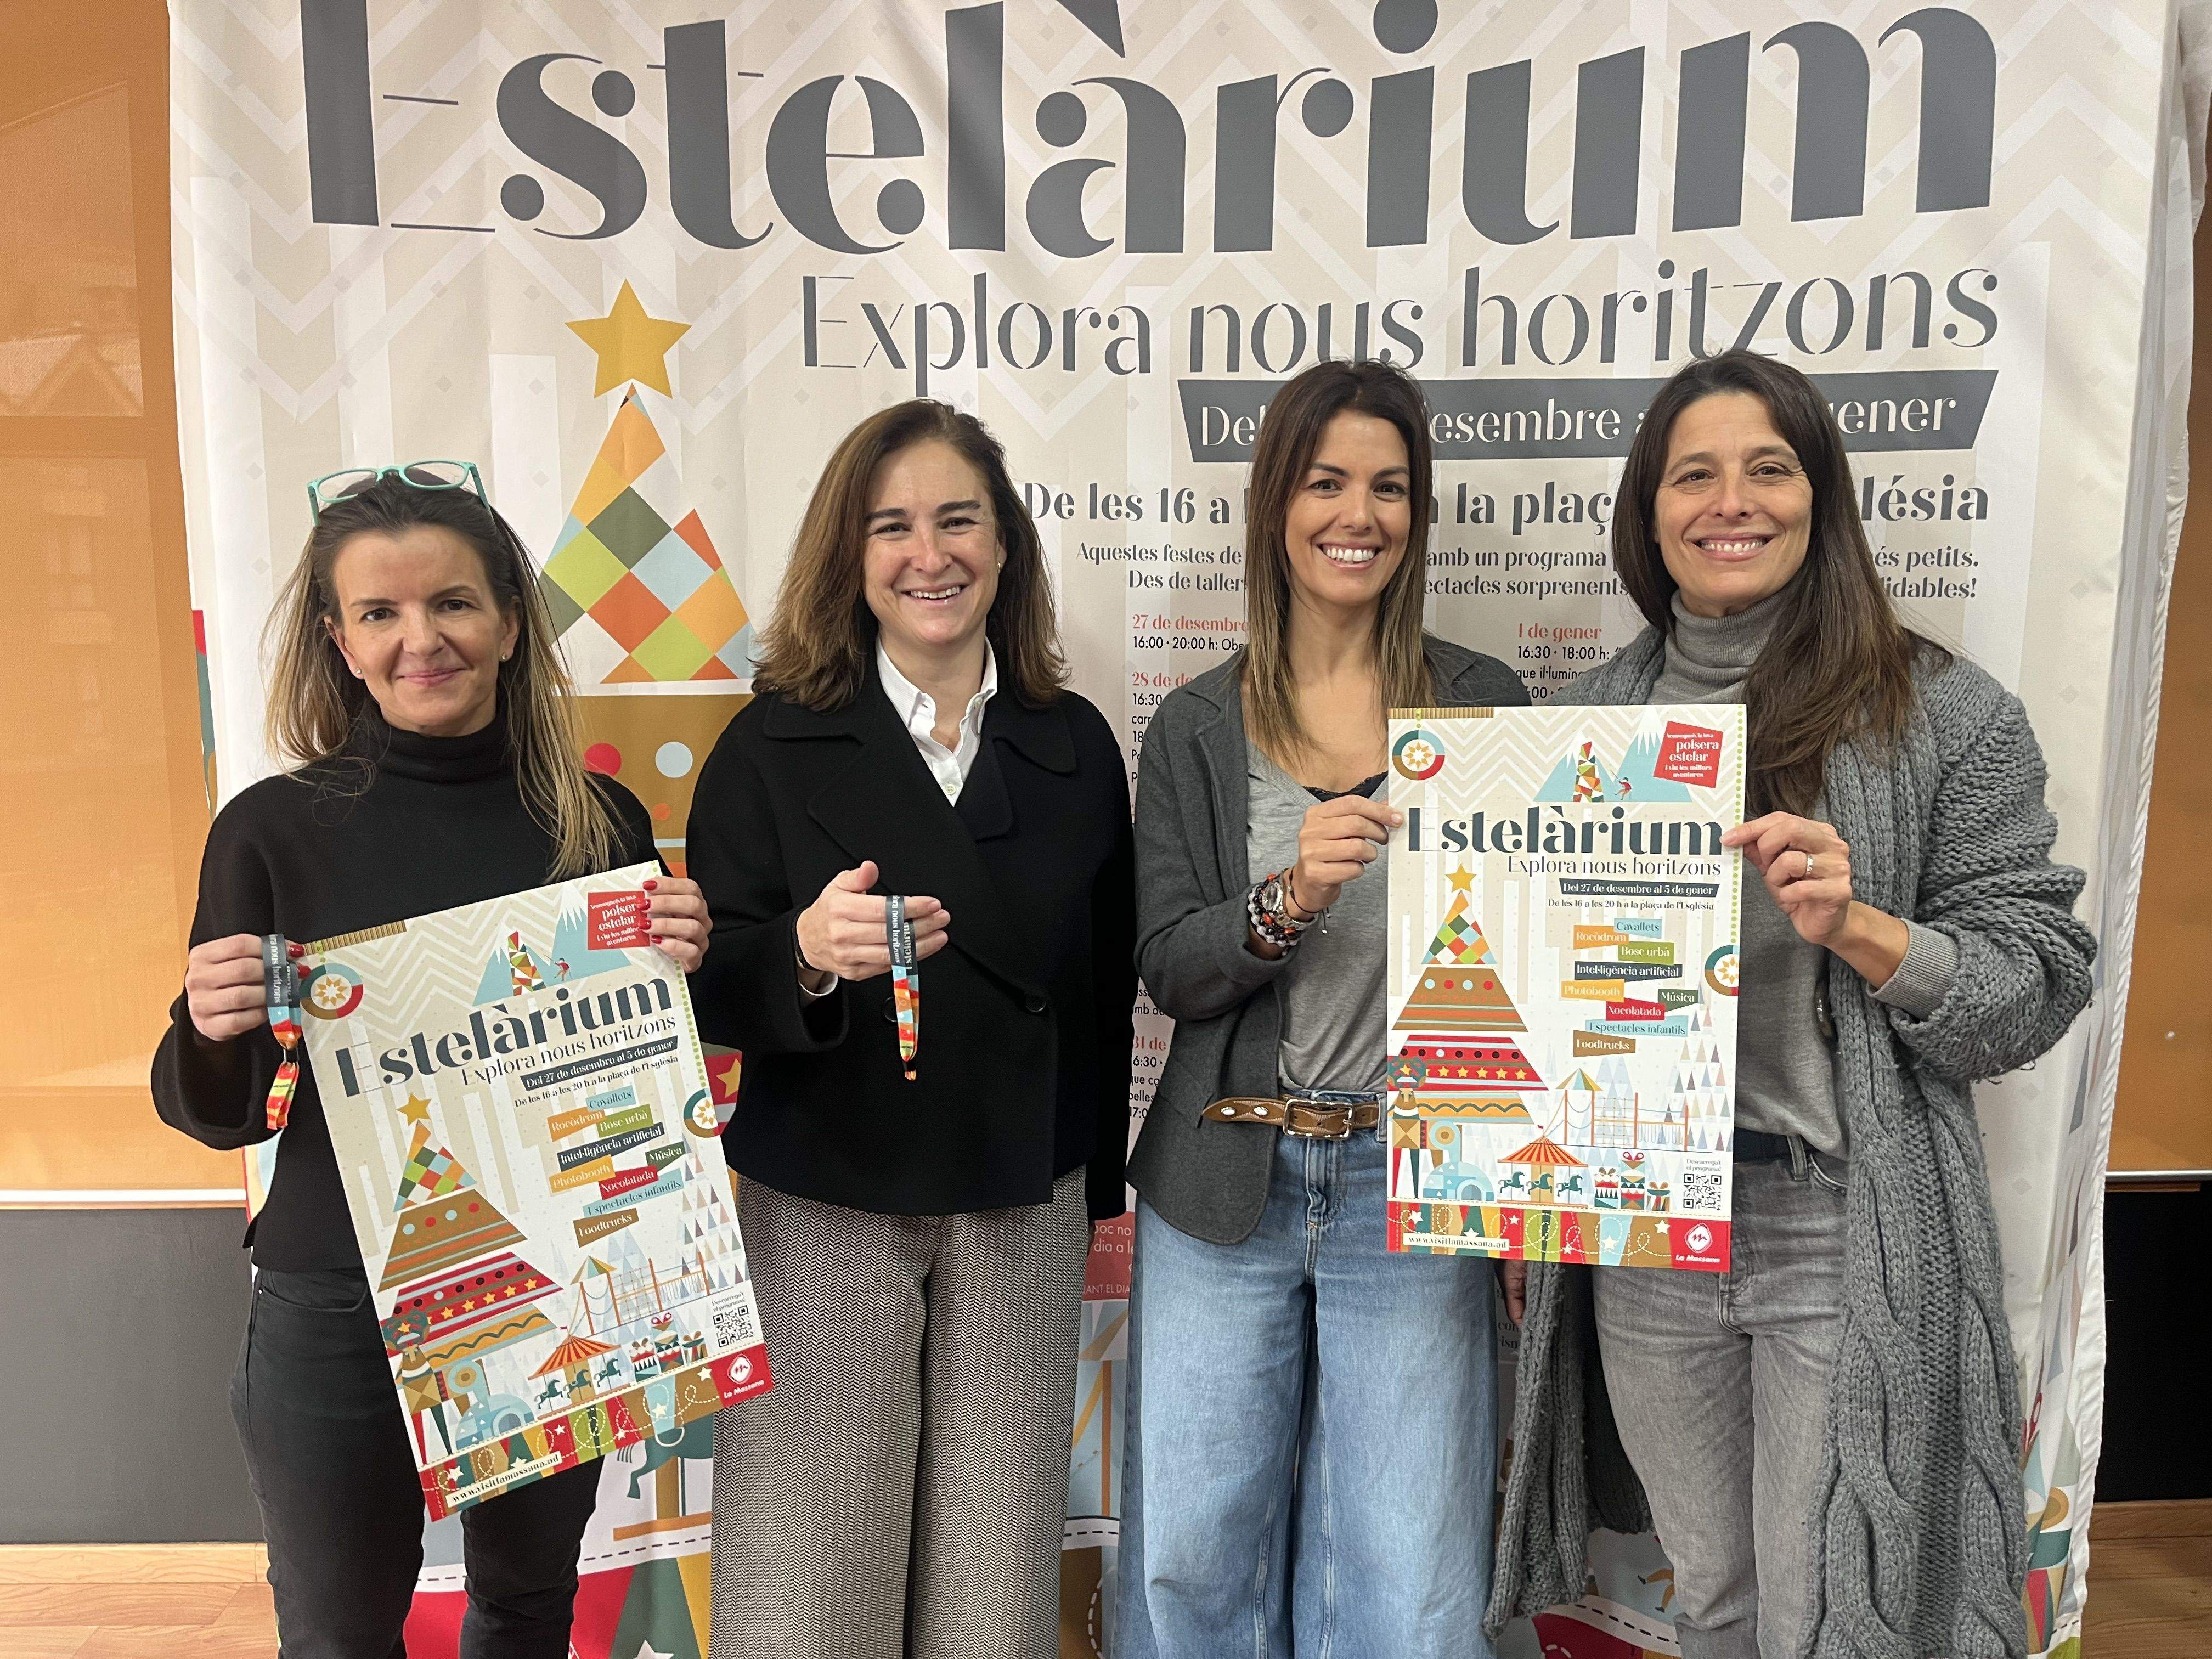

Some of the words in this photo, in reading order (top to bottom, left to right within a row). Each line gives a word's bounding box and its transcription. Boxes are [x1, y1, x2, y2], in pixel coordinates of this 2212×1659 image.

[300, 0, 1998, 259] Estelàrium
[802, 272, 1152, 398] Explora
[1188, 299, 1425, 373] nous
[1460, 259, 1999, 368] horitzons
[1426, 398, 1621, 444] esembre
[1832, 397, 1957, 435] ener
[1024, 482, 1075, 520] De
[1088, 482, 1143, 522] les
[1155, 487, 1195, 524] 16
[1209, 498, 1230, 524] a
[1456, 482, 1496, 524] la
[1512, 481, 1612, 536] plaç
[1861, 473, 1989, 522] lésia
[1076, 541, 1158, 565] Aquestes
[1163, 544, 1215, 565] festes
[1219, 546, 1242, 565] de
[1426, 547, 1469, 566] amb
[1474, 552, 1499, 567] un
[1505, 551, 1607, 572] programa
[1874, 545, 1900, 567] és
[1906, 545, 1979, 573] petits.
[1129, 569, 1164, 589] Des
[1168, 571, 1190, 590] de
[1196, 573, 1245, 592] taller
[1424, 576, 1502, 595] ectacles
[1505, 577, 1629, 600] sorprenents
[1880, 577, 1977, 599] idables!
[1132, 614, 1149, 629] 27
[1152, 614, 1171, 630] de
[1528, 622, 1548, 639] de
[1553, 627, 1602, 643] gener
[1133, 636, 1164, 649] 16:00
[1172, 637, 1205, 650] 20:00
[1208, 637, 1218, 651] h:
[1517, 646, 1551, 659] 16:30
[1562, 646, 1596, 660] 18:00
[1599, 646, 1610, 661] h:
[1132, 672, 1149, 686] 28
[1153, 672, 1171, 687] de
[1515, 669, 1536, 680] que
[1539, 665, 1584, 680] il·lumin
[1132, 693, 1163, 706] 16:30
[1676, 738, 1719, 753] polsera
[1669, 751, 1709, 762] estelar
[1408, 806, 1723, 856] Estelàrium
[1508, 855, 1577, 877] Explora
[1583, 860, 1627, 874] nous
[1633, 857, 1721, 876] horitzons
[1563, 883, 1579, 892] Del
[1581, 883, 1591, 893] 27
[1593, 883, 1605, 893] de
[1606, 884, 1652, 894] desembre
[1654, 884, 1662, 894] al
[1672, 884, 1684, 894] de
[1685, 887, 1714, 896] gener
[601, 903, 637, 922] polser
[1548, 899, 1560, 907] De
[1575, 899, 1583, 907] 16
[1640, 901, 1662, 911] plaça
[599, 915, 636, 932] estelar
[1616, 921, 1660, 932] Cavallets
[1576, 931, 1627, 943] Rocòdrom
[1621, 946, 1645, 956] Bosc
[1646, 947, 1670, 957] urbà
[1577, 964, 1638, 977] Intel·ligència
[1639, 967, 1679, 977] artificial
[1564, 985, 1621, 996] Photobooth
[1661, 991, 1695, 1003] Música
[1607, 1005, 1661, 1017] Xocolatada
[1589, 1022, 1645, 1034] Espectacles
[1647, 1024, 1686, 1035] infantils
[335, 978, 673, 1097] Estelàrium
[1149, 1037, 1166, 1051] de
[1577, 1039, 1630, 1051] Foodtrucks
[461, 1055, 536, 1085] Explora
[541, 1040, 586, 1064] nous
[589, 1015, 676, 1051] horitzons
[526, 1080, 543, 1088] Del
[544, 1072, 554, 1083] 27
[556, 1069, 569, 1080] de
[570, 1057, 616, 1076] desembre
[617, 1052, 625, 1062] al
[634, 1048, 646, 1057] de
[647, 1041, 674, 1056] gener
[1133, 1055, 1157, 1068] 6:30
[515, 1098, 527, 1107] De
[528, 1094, 541, 1103] les
[542, 1091, 551, 1099] 16
[558, 1085, 571, 1094] les
[572, 1081, 583, 1091] 20
[584, 1079, 590, 1088] h
[598, 1075, 606, 1084] la
[607, 1069, 629, 1083] plaça
[630, 1066, 641, 1074] de
[589, 1090, 633, 1109] Cavallets
[551, 1110, 603, 1133] Rocòdrom
[600, 1118, 624, 1133] Bosc
[625, 1110, 648, 1125] urbà
[560, 1139, 622, 1165] Intel·ligència
[623, 1125, 662, 1146] artificial
[649, 1146, 682, 1162] Música
[552, 1164, 610, 1189] Photobooth
[601, 1170, 654, 1193] Xocolatada
[588, 1193, 644, 1216] Espectacles
[644, 1180, 681, 1198] infantils
[579, 1214, 633, 1237] Foodtrucks
[1094, 1238, 1113, 1252] dia
[1116, 1244, 1124, 1254] a
[1408, 1236, 1506, 1249] www.visitlamassana.ad
[1675, 1254, 1685, 1262] La
[1686, 1255, 1720, 1263] Massana
[724, 1391, 733, 1399] La
[733, 1379, 765, 1395] Massana
[452, 1454, 560, 1503] www.visitlamassana.ad
